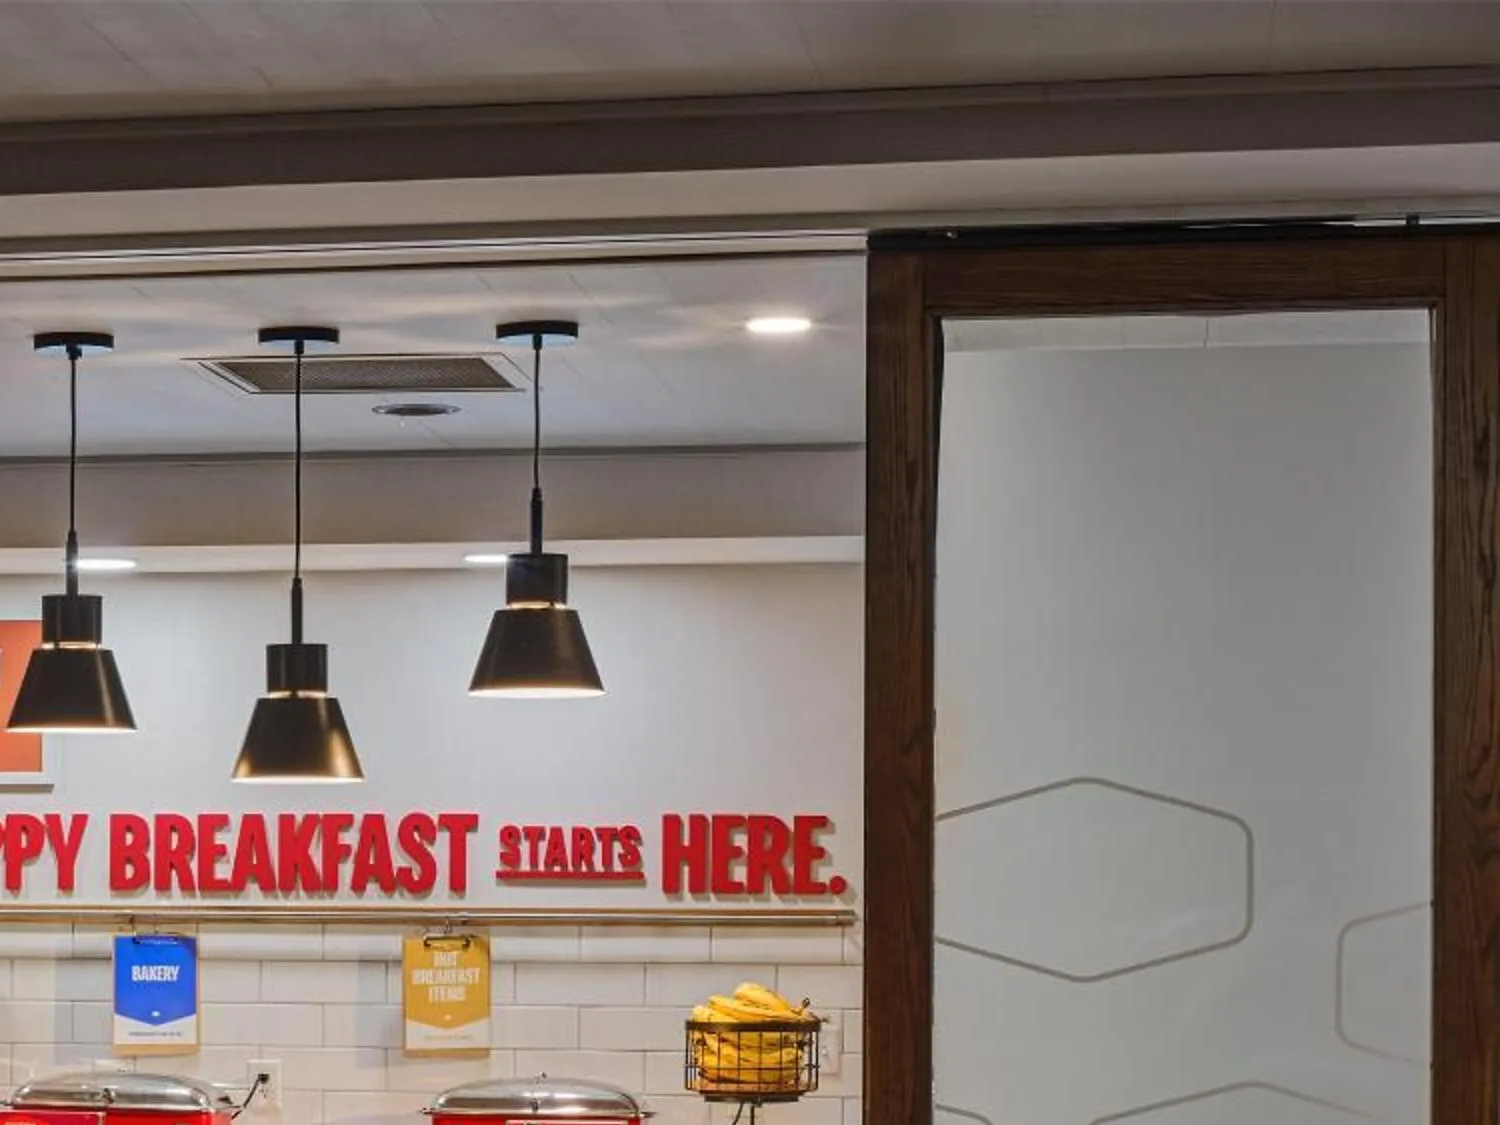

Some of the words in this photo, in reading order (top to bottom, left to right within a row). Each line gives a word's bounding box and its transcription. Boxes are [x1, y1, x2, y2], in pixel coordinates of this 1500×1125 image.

[109, 813, 479, 894] BREAKFAST
[498, 825, 642, 874] STARTS
[662, 814, 847, 895] HERE.
[131, 965, 180, 981] BAKERY
